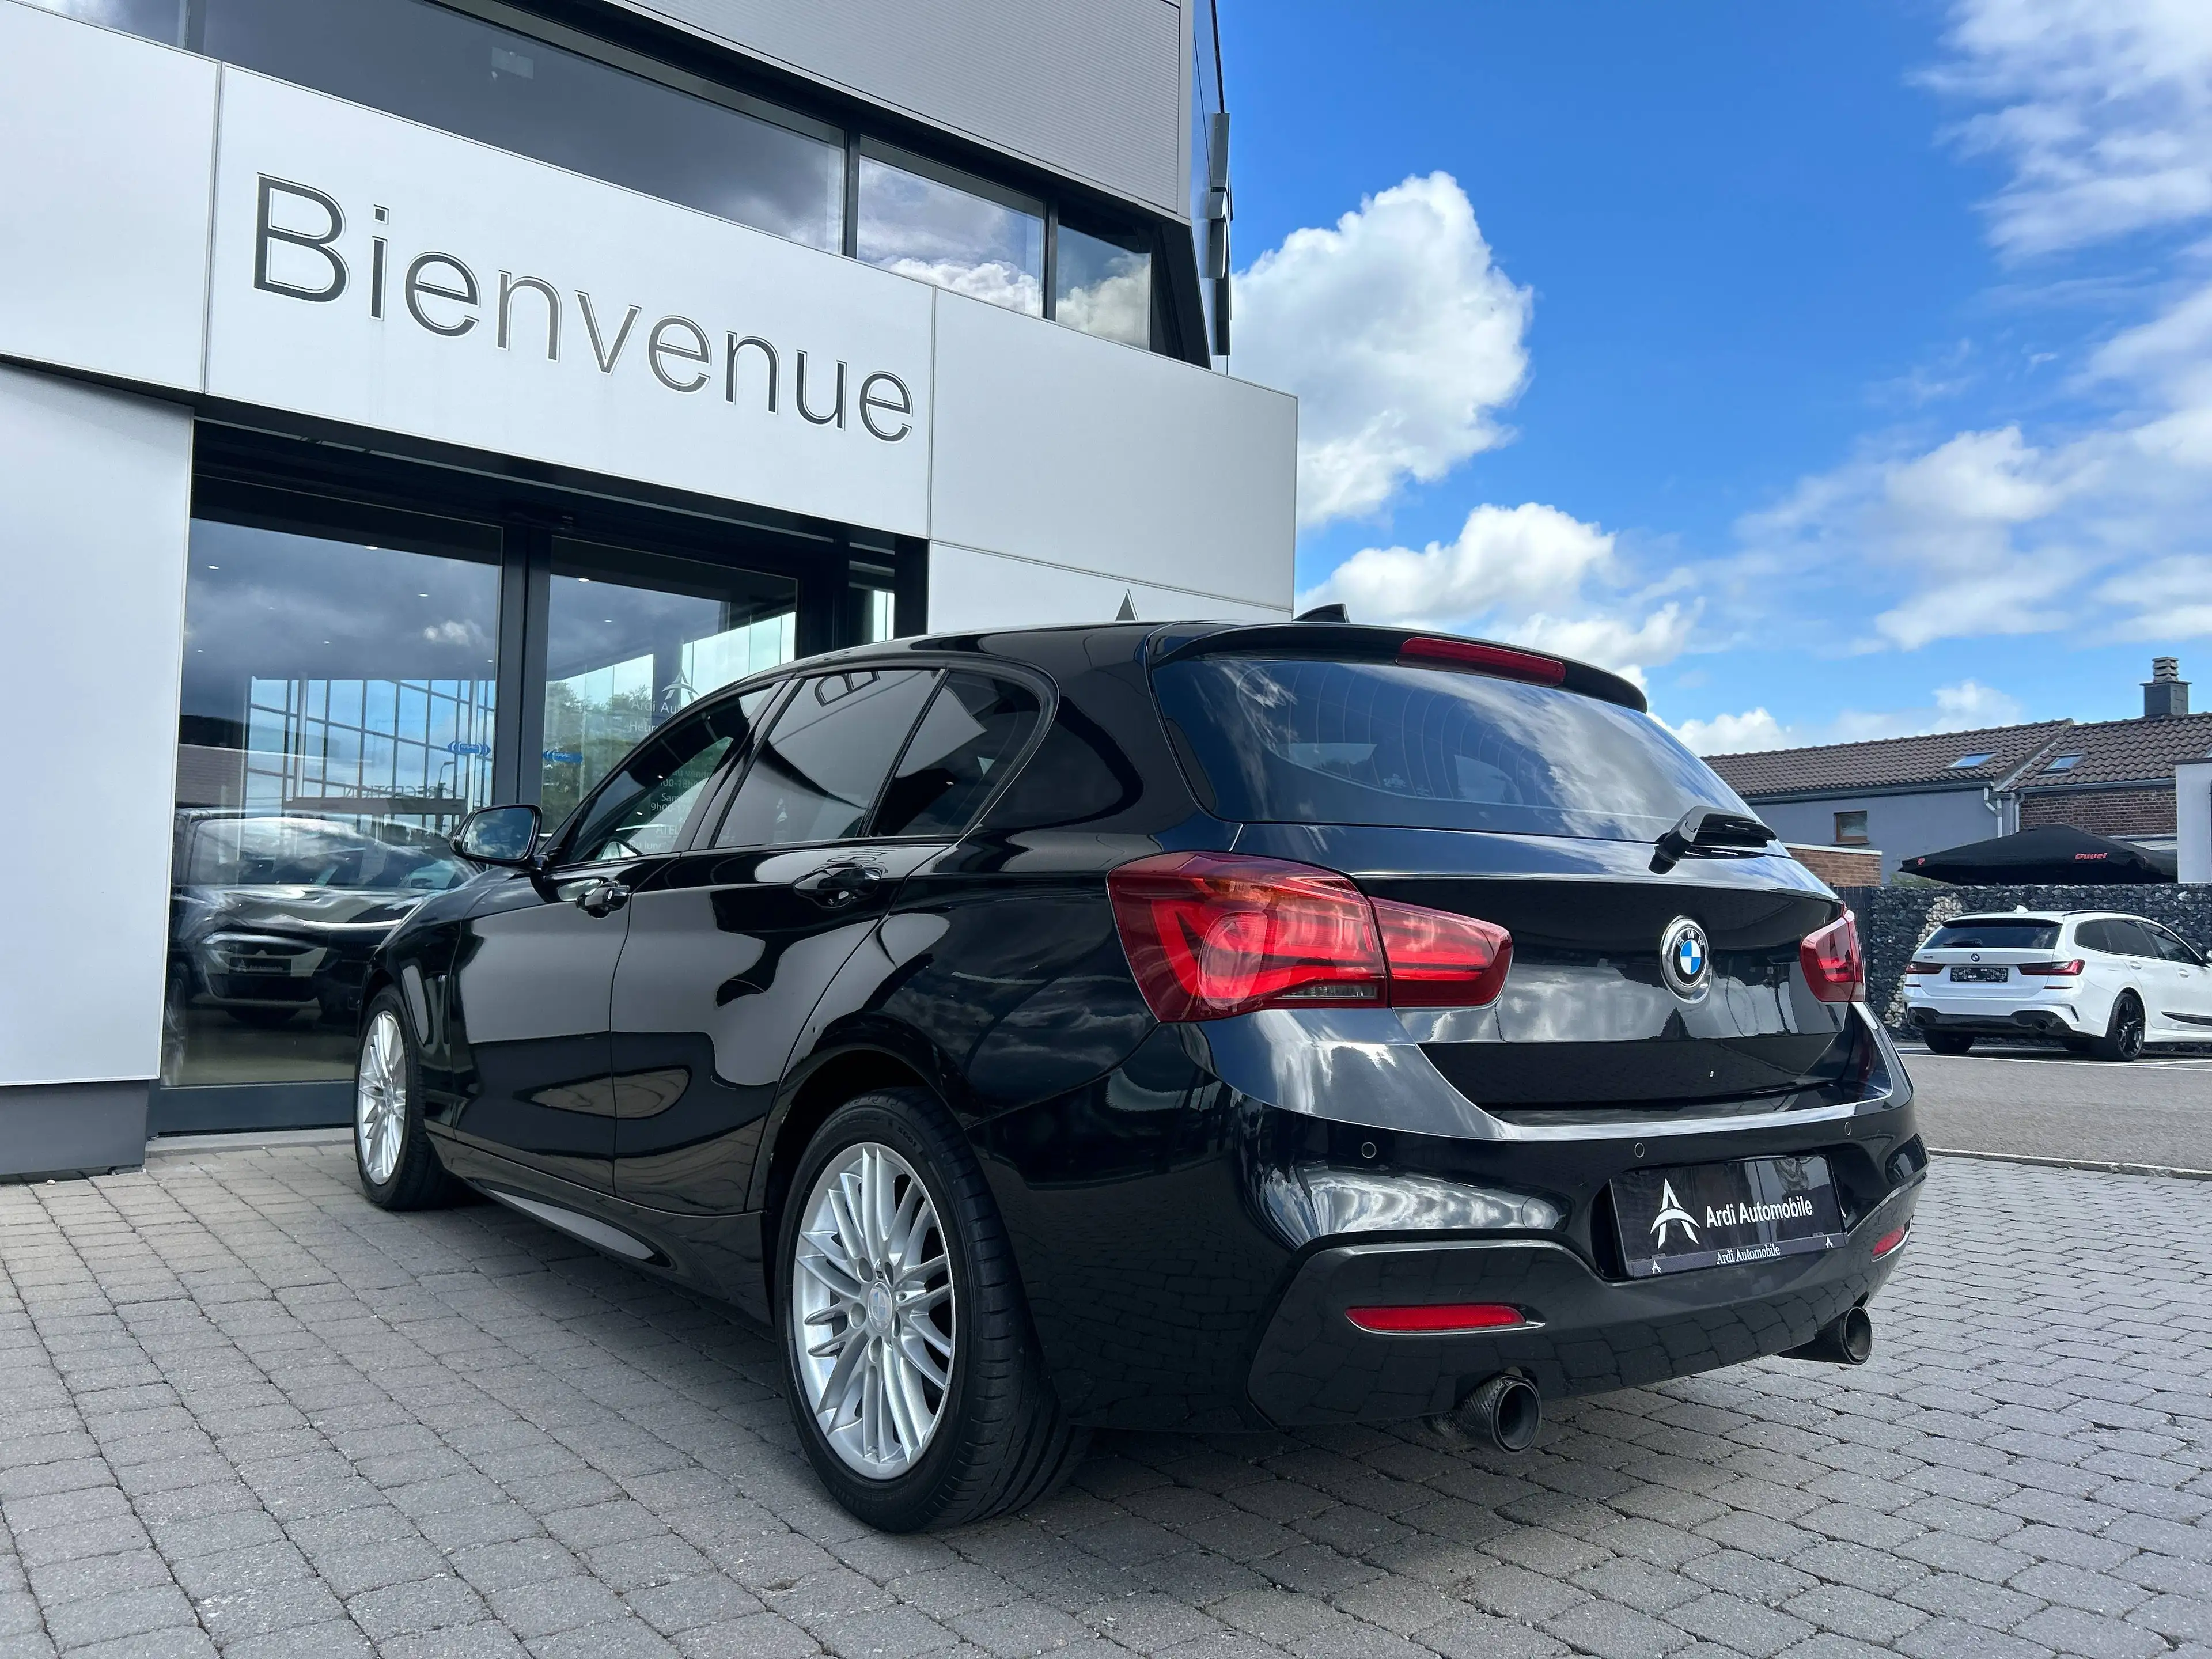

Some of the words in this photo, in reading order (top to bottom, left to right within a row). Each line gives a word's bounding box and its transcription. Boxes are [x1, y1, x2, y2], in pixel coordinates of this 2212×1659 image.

[253, 172, 913, 443] Bienvenue
[631, 700, 656, 713] Ardi
[660, 702, 682, 714] Aut
[630, 721, 659, 732] Heur
[1676, 930, 1705, 948] BMW
[1706, 1203, 1737, 1228] Ardi
[1740, 1195, 1813, 1224] Automobile
[1716, 1249, 1736, 1264] Ardi
[1736, 1243, 1781, 1262] Automobile
